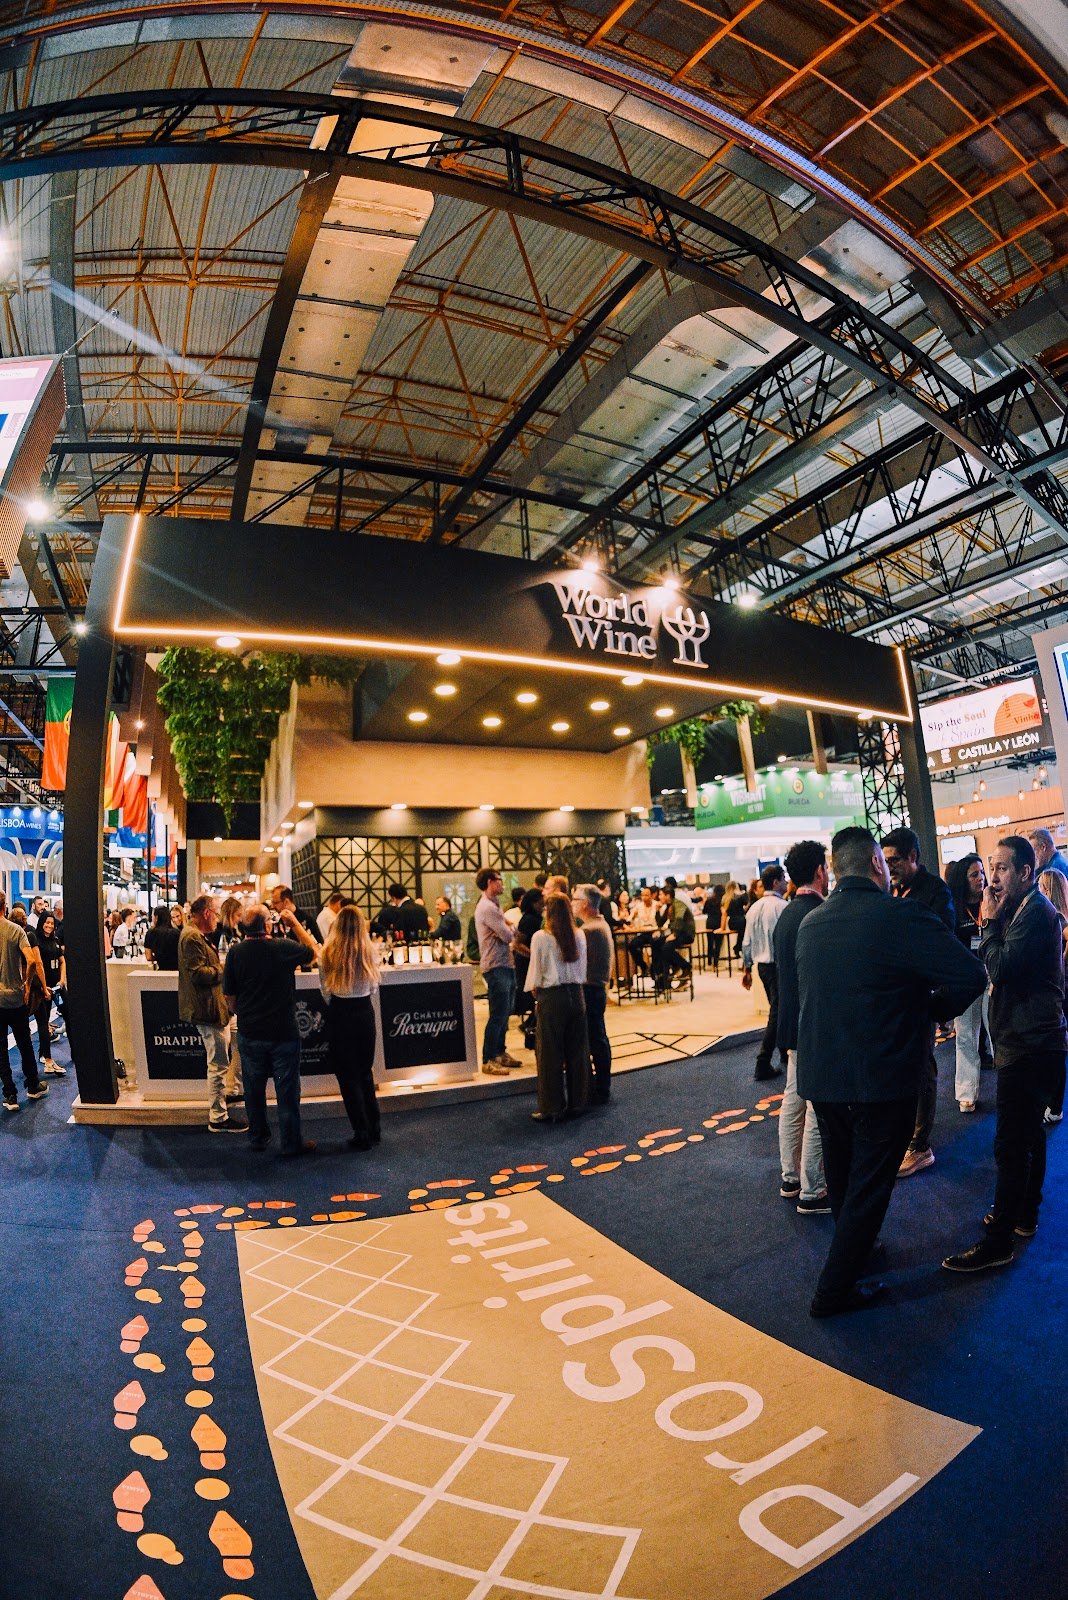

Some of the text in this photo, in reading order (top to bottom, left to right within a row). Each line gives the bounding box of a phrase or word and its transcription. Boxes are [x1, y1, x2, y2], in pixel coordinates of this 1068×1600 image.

[551, 582, 655, 628] World
[562, 613, 657, 659] Wine
[928, 709, 987, 732] Sip the Soul
[957, 744, 1003, 760] CASTILLA
[1001, 740, 1011, 750] Y
[1012, 732, 1039, 748] LEÓN
